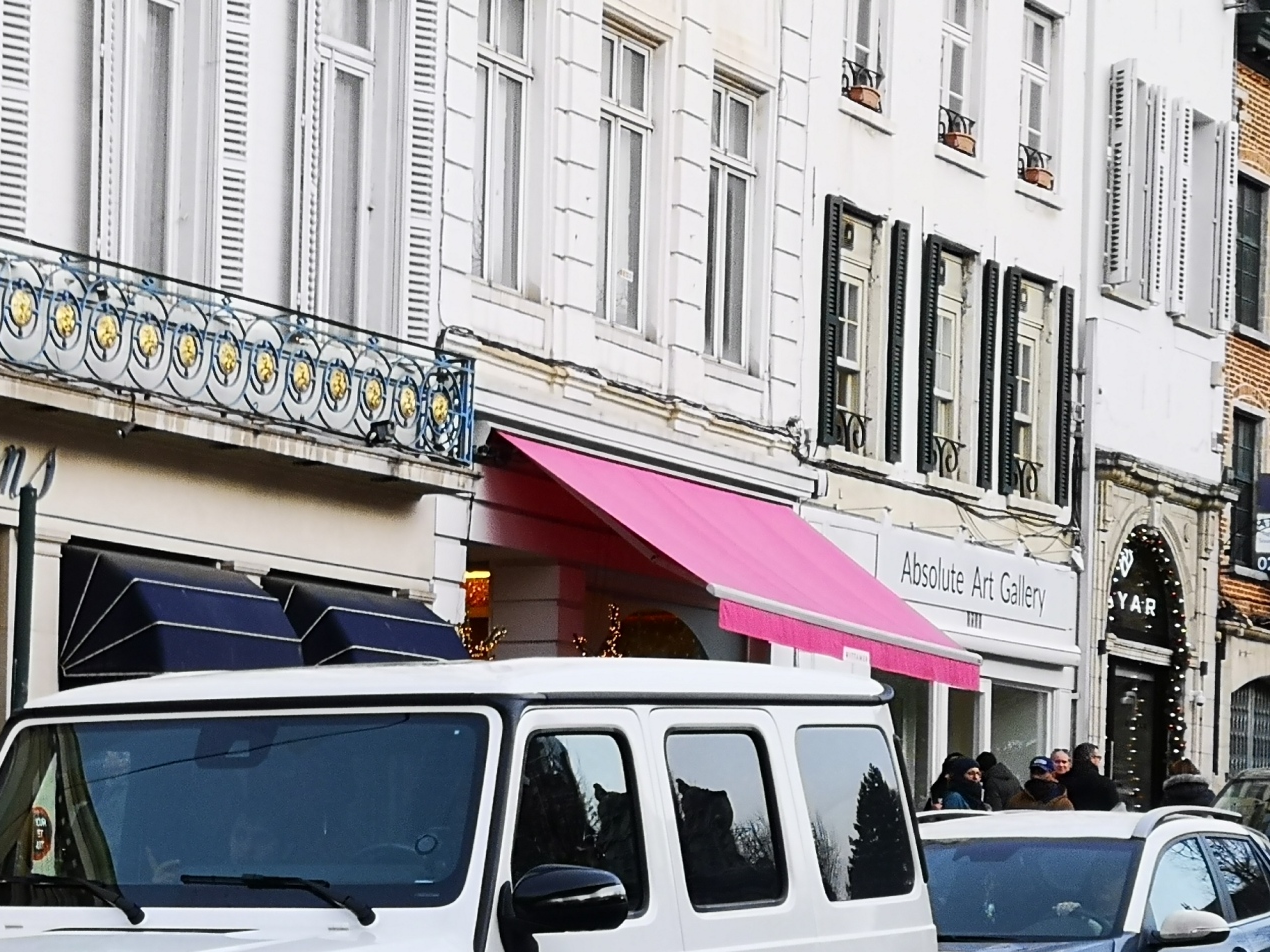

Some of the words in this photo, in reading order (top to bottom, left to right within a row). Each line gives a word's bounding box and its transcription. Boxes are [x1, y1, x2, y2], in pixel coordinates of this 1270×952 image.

[901, 551, 964, 595] Absolute
[971, 566, 994, 601] Art
[1000, 572, 1046, 617] Gallery
